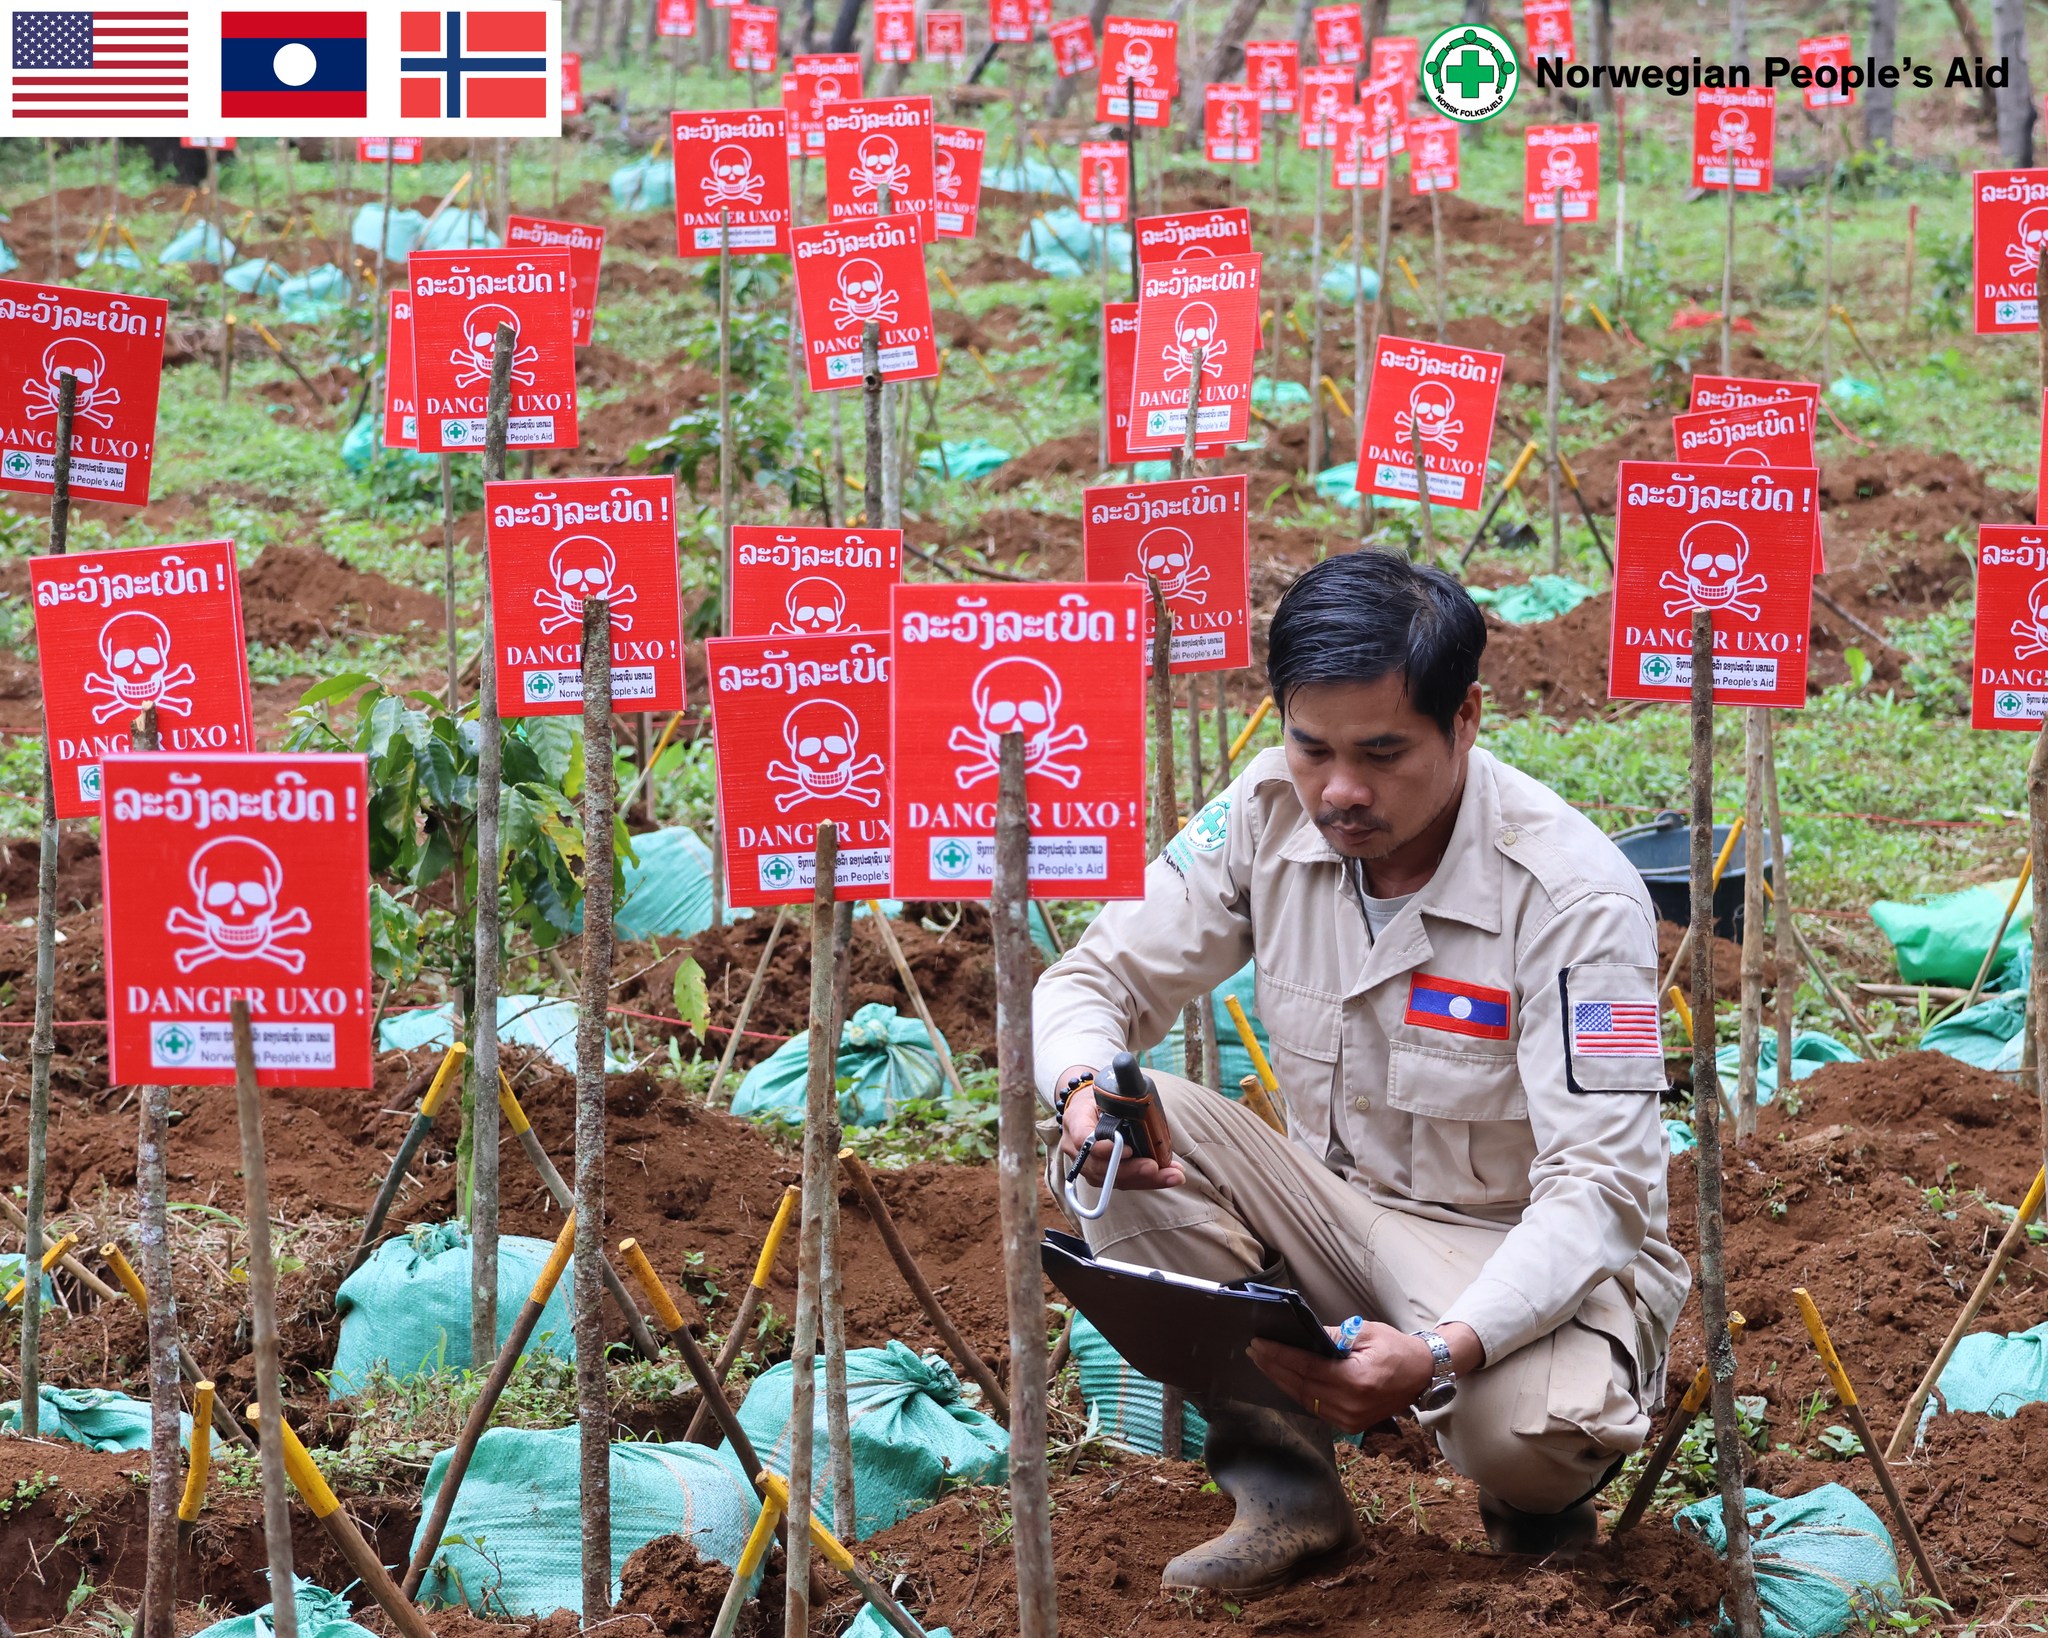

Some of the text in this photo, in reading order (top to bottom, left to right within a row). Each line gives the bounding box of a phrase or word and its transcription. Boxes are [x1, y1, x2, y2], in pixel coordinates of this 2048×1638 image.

[750, 210, 781, 223] UXO
[834, 202, 879, 217] DANG
[896, 200, 926, 214] UXO
[814, 335, 862, 355] DANG
[886, 328, 920, 344] UXO
[427, 397, 489, 414] DANG
[519, 394, 561, 411] UXO
[1140, 389, 1191, 407] DANGE
[1207, 385, 1238, 401] UXO
[0, 426, 83, 453] ANGR
[90, 437, 137, 460] UXO
[541, 433, 552, 441] Aid
[1369, 446, 1435, 470] DANGR
[1439, 457, 1474, 475] UXO
[111, 479, 123, 488] Aid
[1191, 611, 1232, 629] UXO
[1626, 627, 1728, 649] DANGR
[1738, 632, 1788, 651] UXO
[508, 644, 581, 665] DANG
[614, 641, 663, 660] UXO
[1212, 649, 1223, 657] Aid
[640, 685, 653, 695] Aid
[1723, 676, 1758, 688] People's
[1760, 677, 1774, 687] Aid
[59, 732, 168, 761] DANGR
[173, 726, 227, 750] UXO
[910, 803, 1042, 827] DANGR
[1053, 802, 1120, 827] UXO
[860, 820, 890, 841] UX
[800, 870, 889, 884] Norian People's
[1038, 863, 1082, 876] People's
[1086, 863, 1103, 875] Aid
[278, 988, 346, 1014] UXO
[264, 1051, 310, 1065] People's
[314, 1051, 332, 1063] Aid
